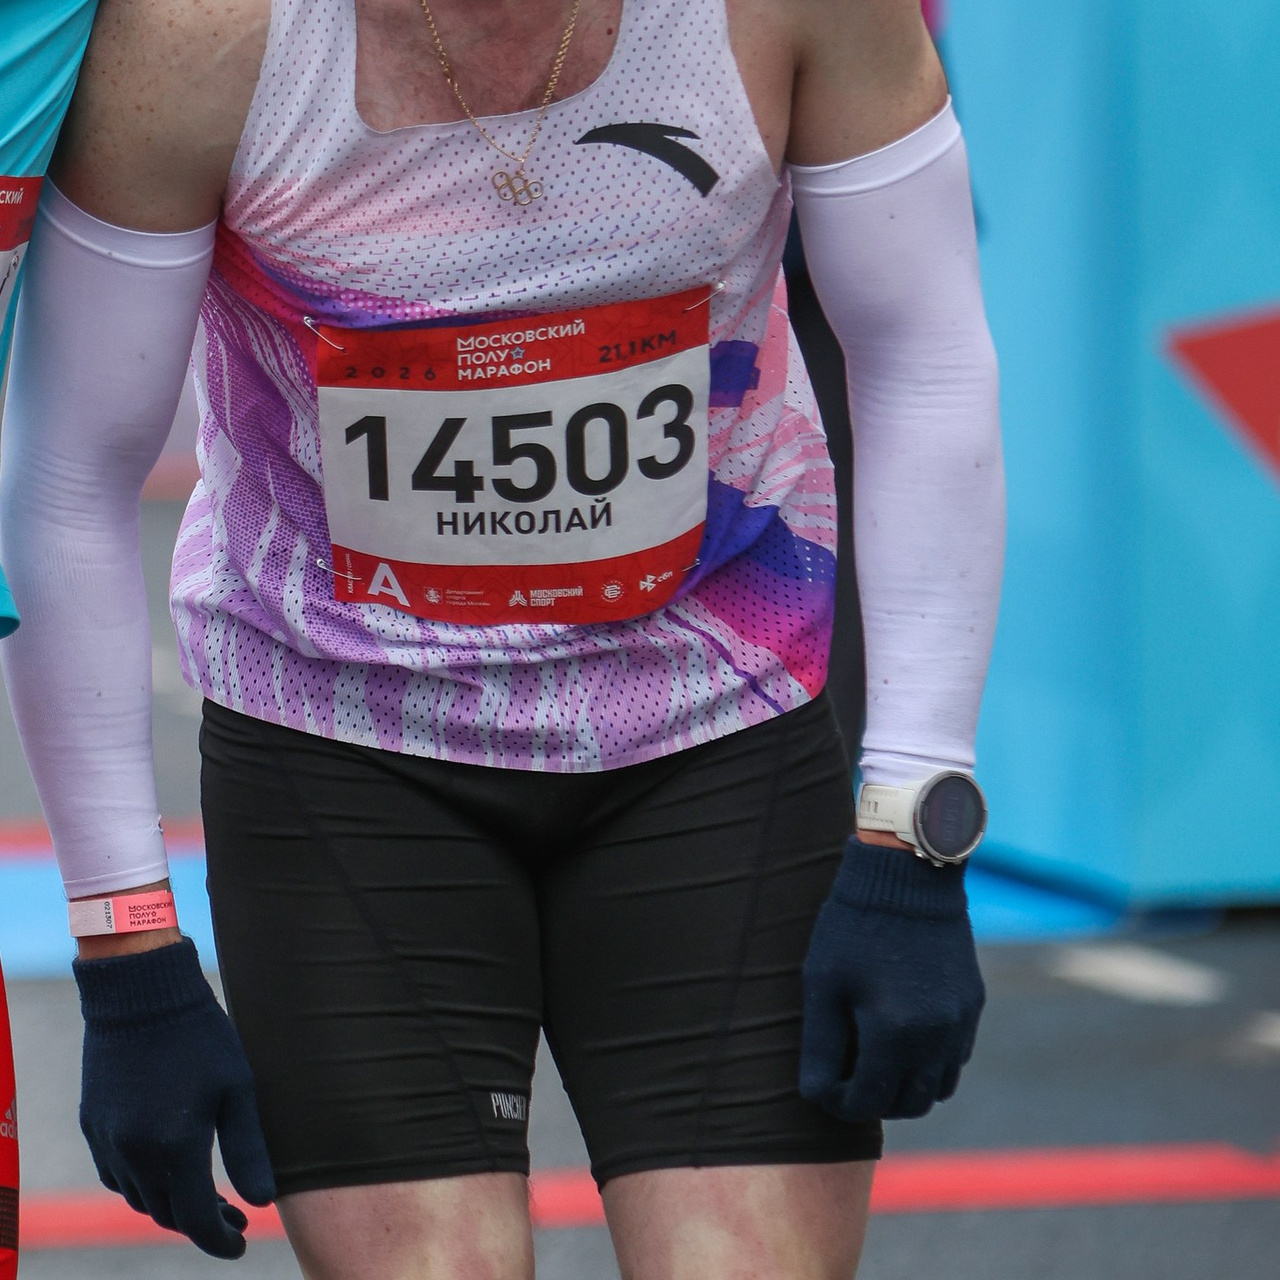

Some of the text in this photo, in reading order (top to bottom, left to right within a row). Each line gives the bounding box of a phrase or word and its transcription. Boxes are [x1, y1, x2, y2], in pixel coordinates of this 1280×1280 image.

[456, 319, 586, 352] МОСКОВСКИЙ
[457, 349, 509, 367] ПОЛУ
[345, 366, 437, 381] 2026
[457, 358, 552, 381] МАРАФОН
[345, 383, 696, 504] 14503
[436, 497, 613, 536] НИКОЛАЙ
[529, 586, 584, 599] МОСКОВСКИЙ
[530, 597, 556, 607] СПОРТ
[129, 911, 149, 920] ПОЛУ
[130, 917, 167, 927] МАРАФОН
